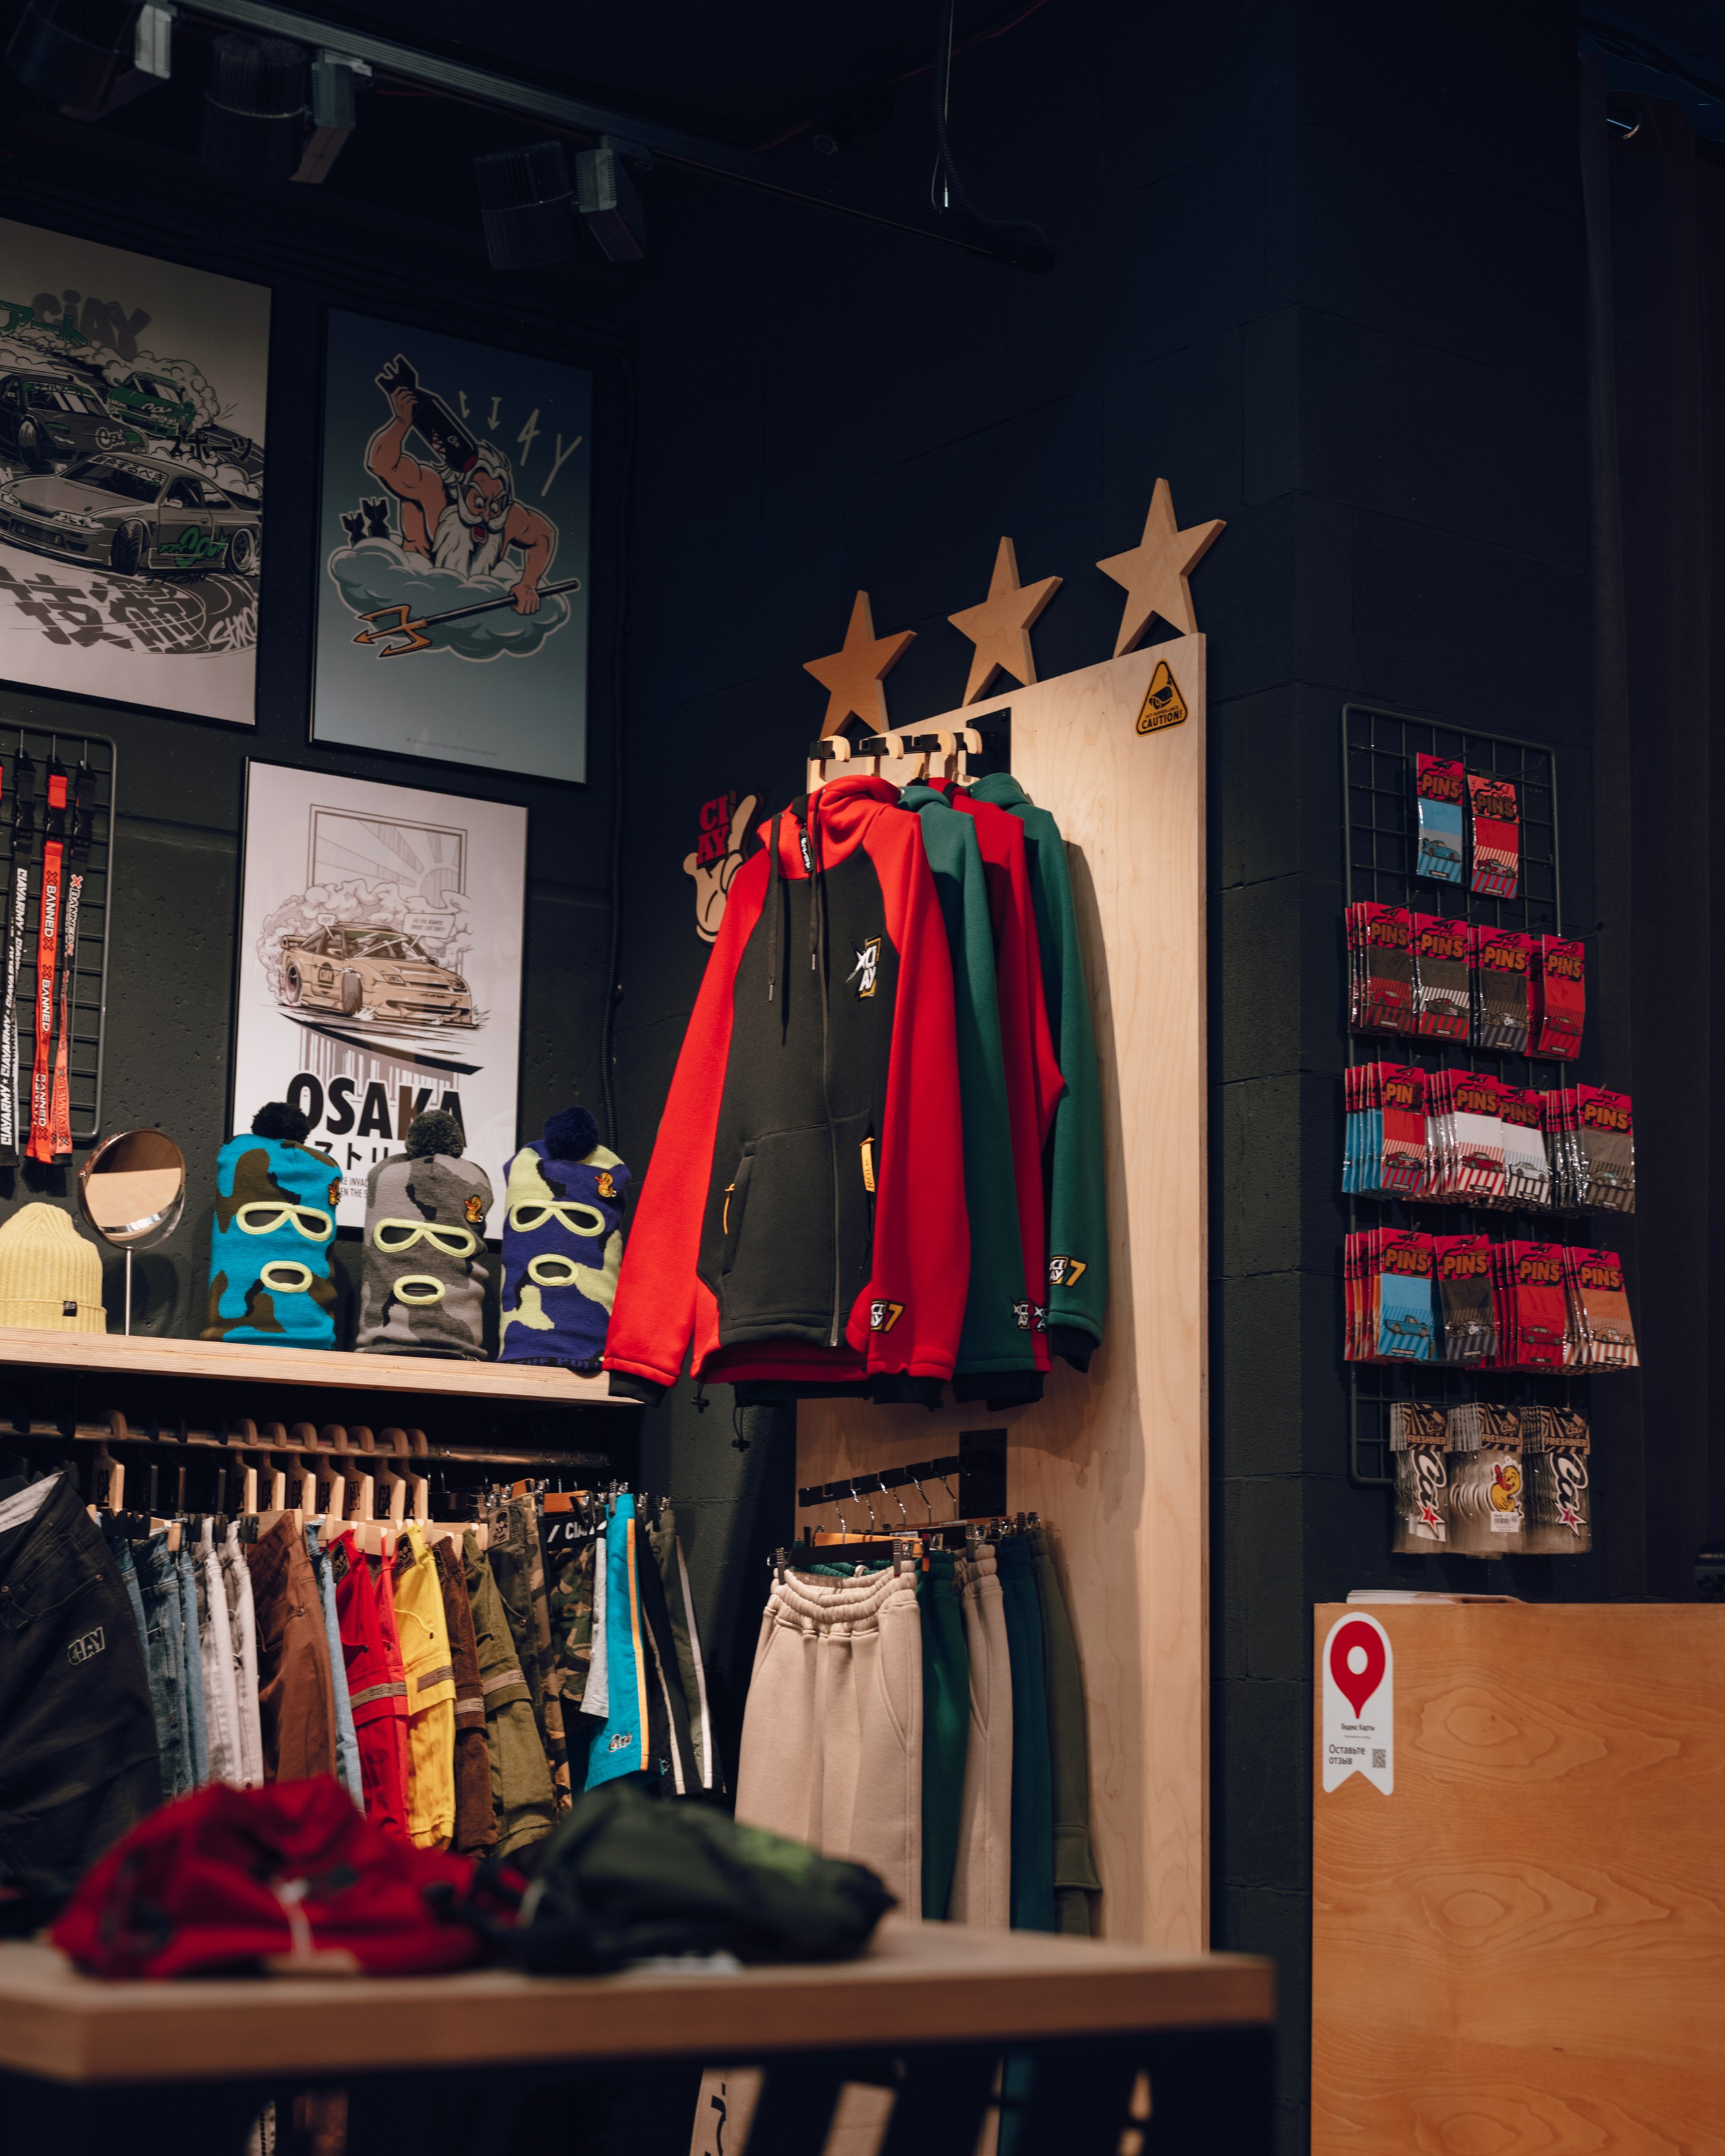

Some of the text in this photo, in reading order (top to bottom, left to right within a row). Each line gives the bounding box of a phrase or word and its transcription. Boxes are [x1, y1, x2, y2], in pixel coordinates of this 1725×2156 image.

[1141, 709, 1183, 730] CAUTION!
[1422, 773, 1460, 798] PINS
[1476, 794, 1514, 817] PINS
[1371, 922, 1408, 947] PINS
[1420, 933, 1464, 957] PINS
[1483, 946, 1527, 970] PINS
[1546, 954, 1581, 978] PINS
[1385, 1082, 1422, 1105] PINS
[1456, 1089, 1497, 1111] PINS
[286, 1073, 468, 1148] OSAKA
[1500, 1102, 1536, 1124] PINS
[1584, 1104, 1629, 1129] PINS
[1384, 1248, 1429, 1271] PINS
[1443, 1254, 1487, 1275] PINS
[1519, 1260, 1561, 1282] PINS
[1065, 1259, 1087, 1287] 7
[1581, 1266, 1620, 1288] PINS
[883, 1303, 904, 1331] 7
[1406, 1434, 1447, 1445] FRESHNER
[1481, 1432, 1521, 1445] FRESHNER
[1545, 1436, 1588, 1447] FRESHNER
[1328, 1744, 1366, 1756] Оставьте
[1328, 1754, 1353, 1765] отзыв
